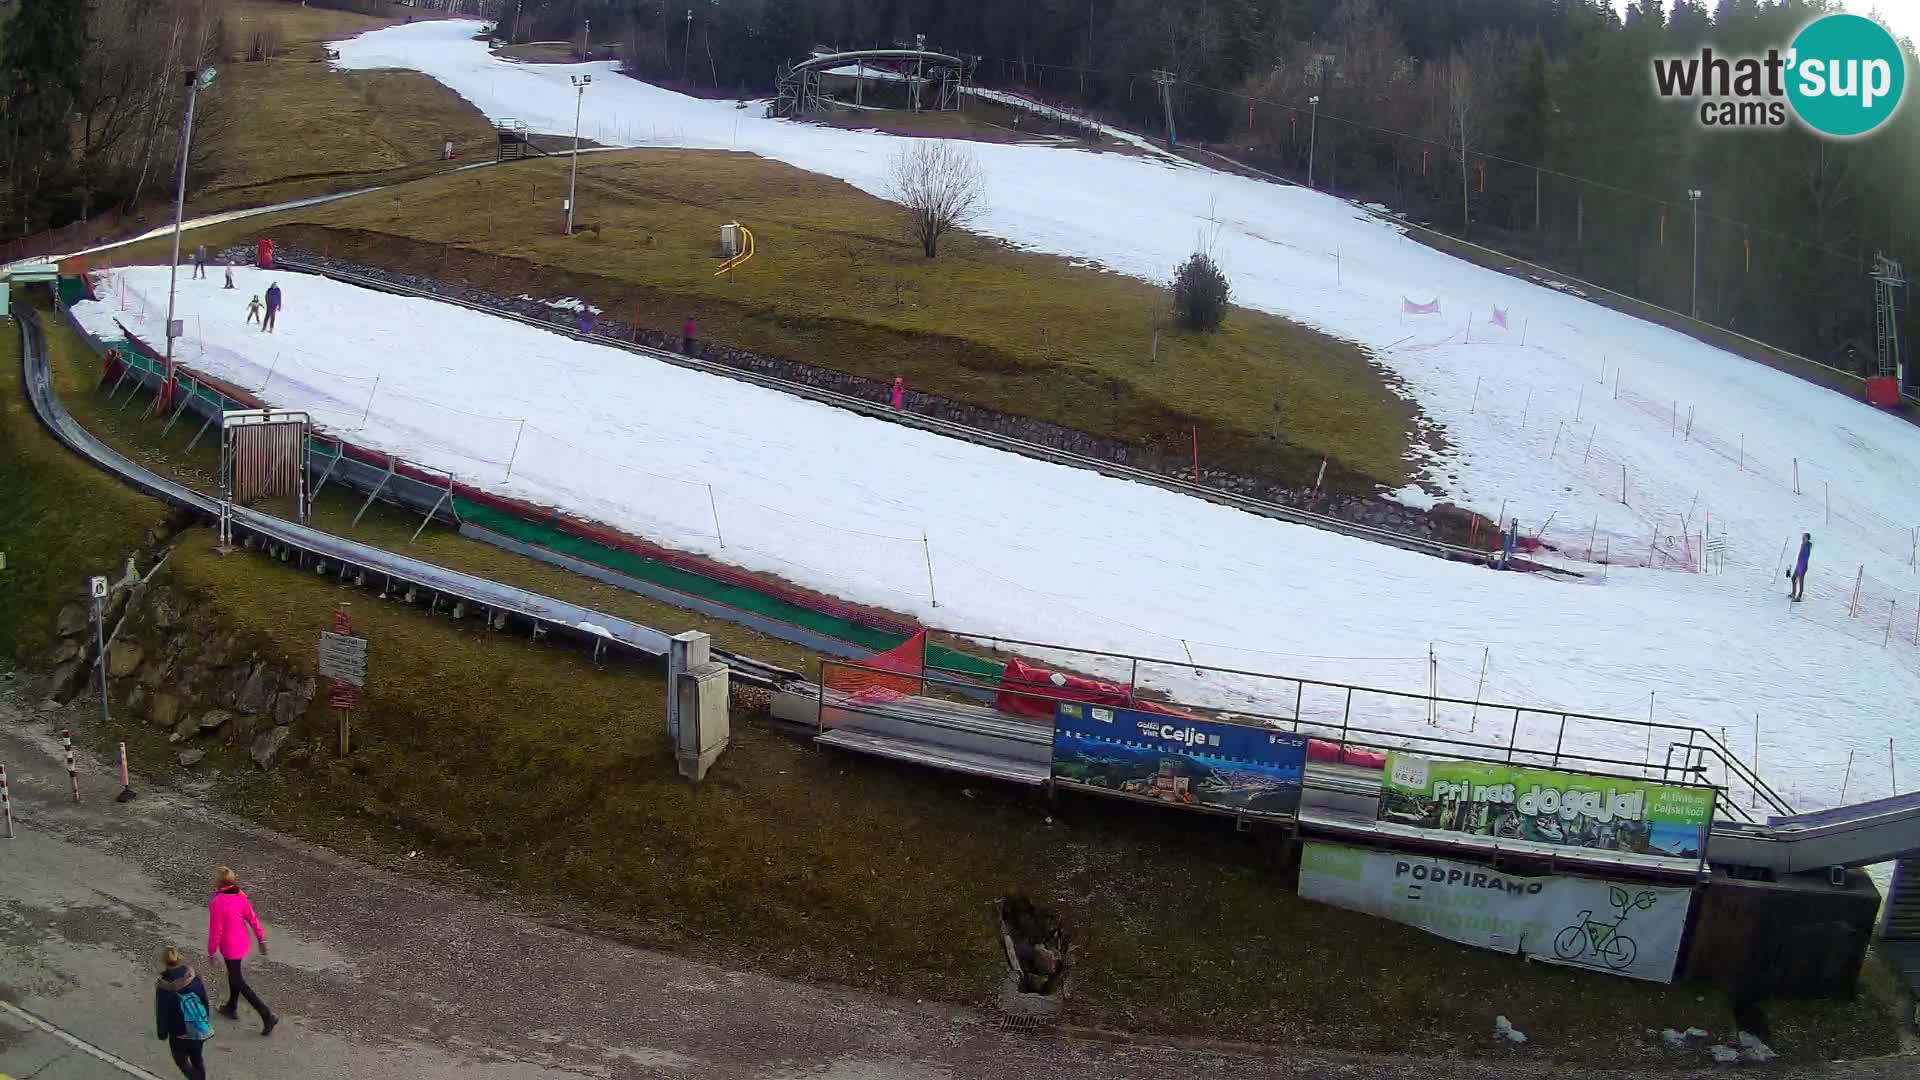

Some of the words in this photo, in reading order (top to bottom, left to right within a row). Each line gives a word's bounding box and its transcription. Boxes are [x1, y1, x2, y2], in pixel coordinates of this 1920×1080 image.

[1160, 724, 1206, 747] Celje
[1432, 779, 1469, 802] Pri
[1473, 783, 1516, 803] nas
[1516, 784, 1645, 823] dogaja!
[1395, 861, 1543, 895] PODPIRAMO
